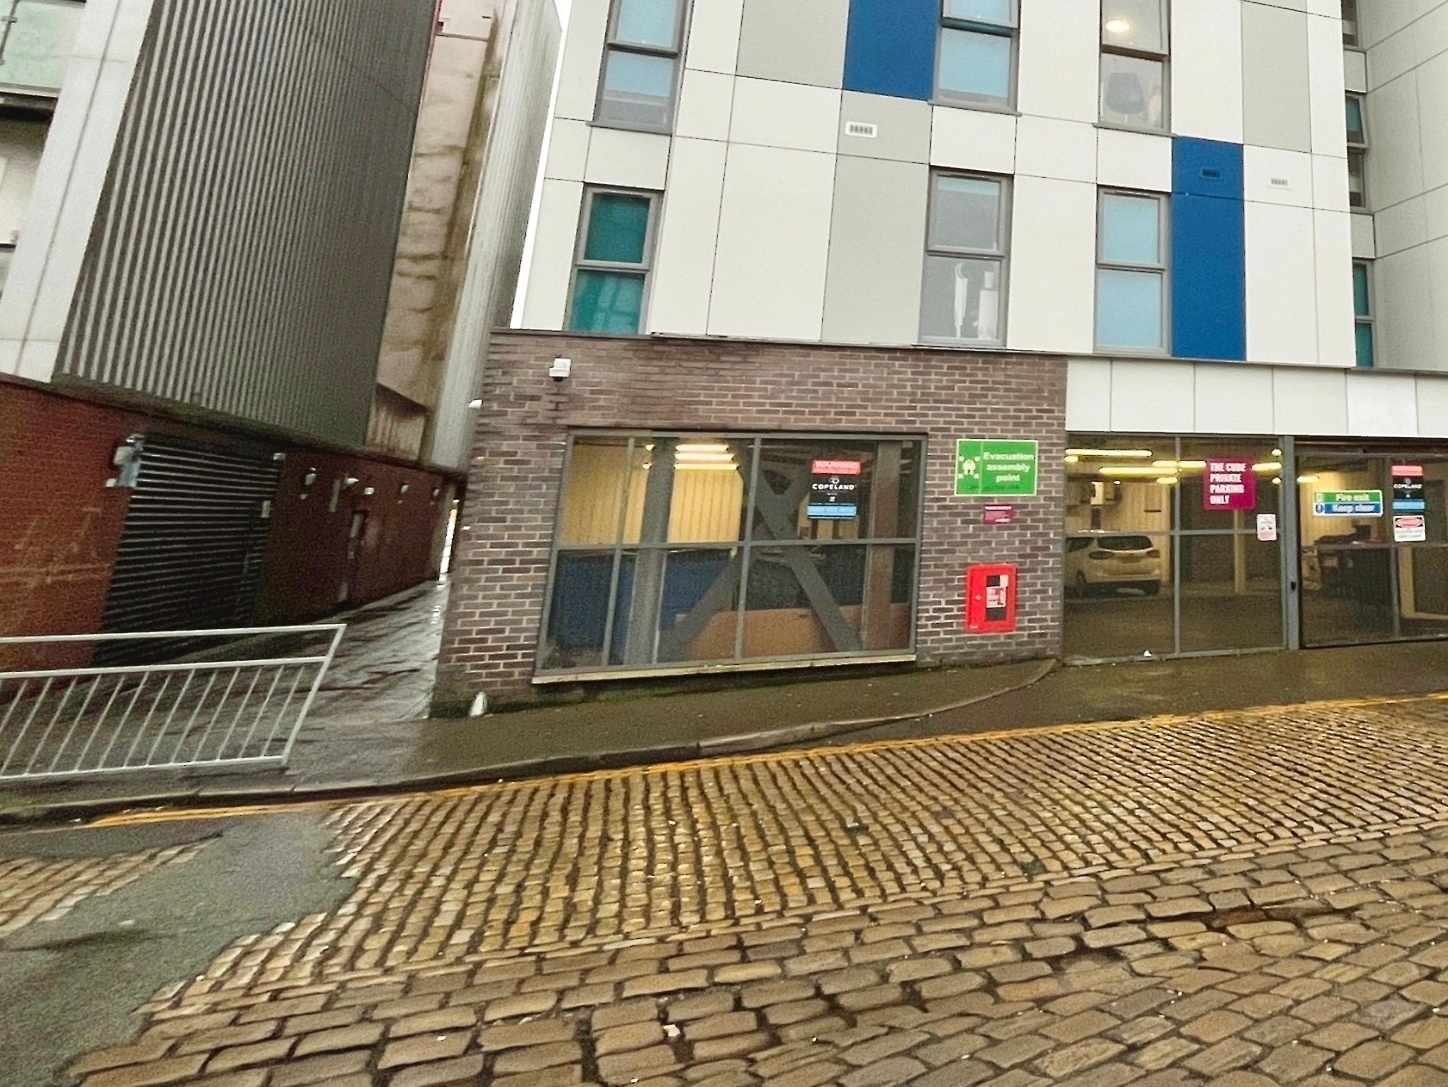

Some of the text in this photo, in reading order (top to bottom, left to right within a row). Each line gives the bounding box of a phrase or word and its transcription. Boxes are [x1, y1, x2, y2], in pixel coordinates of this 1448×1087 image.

[983, 452, 1034, 461] Evacuation
[986, 463, 1031, 473] assembly
[1210, 462, 1224, 472] THE
[996, 474, 1020, 483] point
[1210, 473, 1242, 483] PRIVATE
[812, 483, 855, 491] COPELAND
[1209, 495, 1230, 505] ONLY
[1335, 493, 1353, 502] Fire
